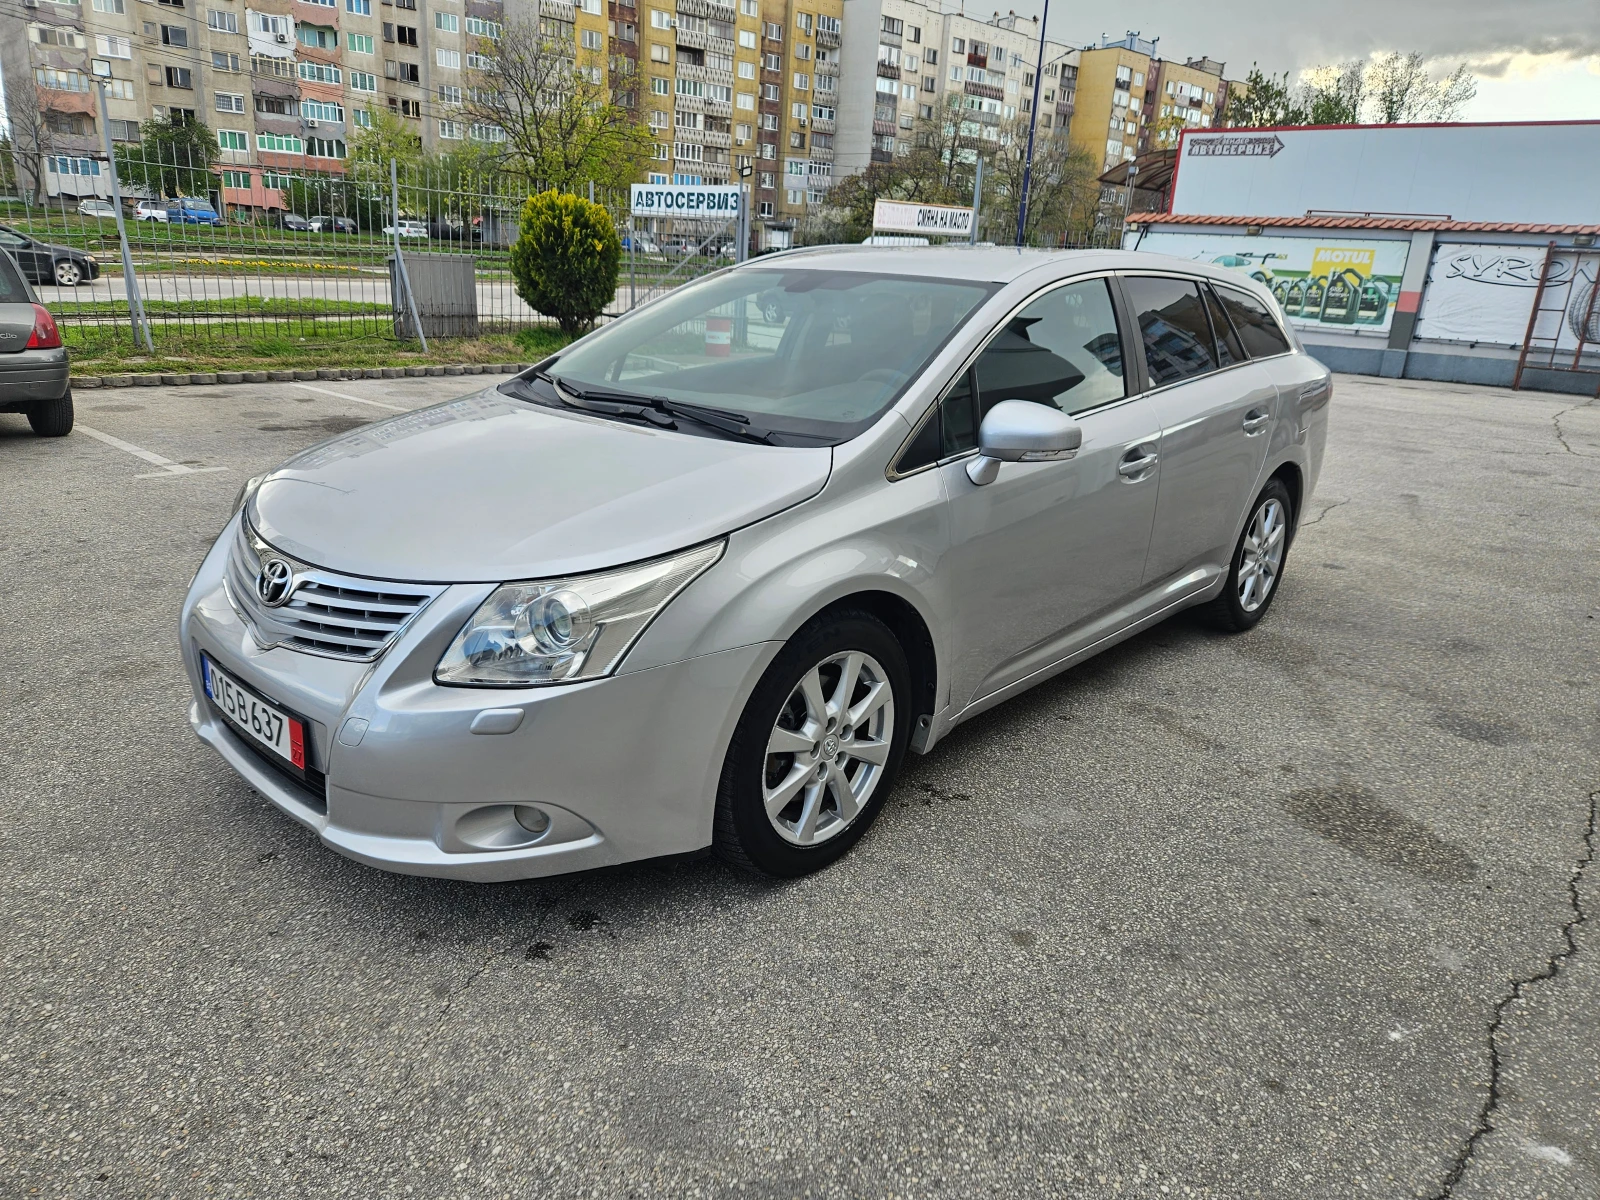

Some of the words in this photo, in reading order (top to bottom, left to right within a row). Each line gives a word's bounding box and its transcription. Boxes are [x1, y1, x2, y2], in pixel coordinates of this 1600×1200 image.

[1191, 144, 1271, 155] АВТОСЕРВИЗ
[635, 190, 740, 211] АВТОСЕРВИЗ
[917, 208, 938, 227] СМЯНА
[939, 210, 948, 229] НА
[948, 211, 970, 230] МАСЛО
[1316, 249, 1371, 264] MOTUL
